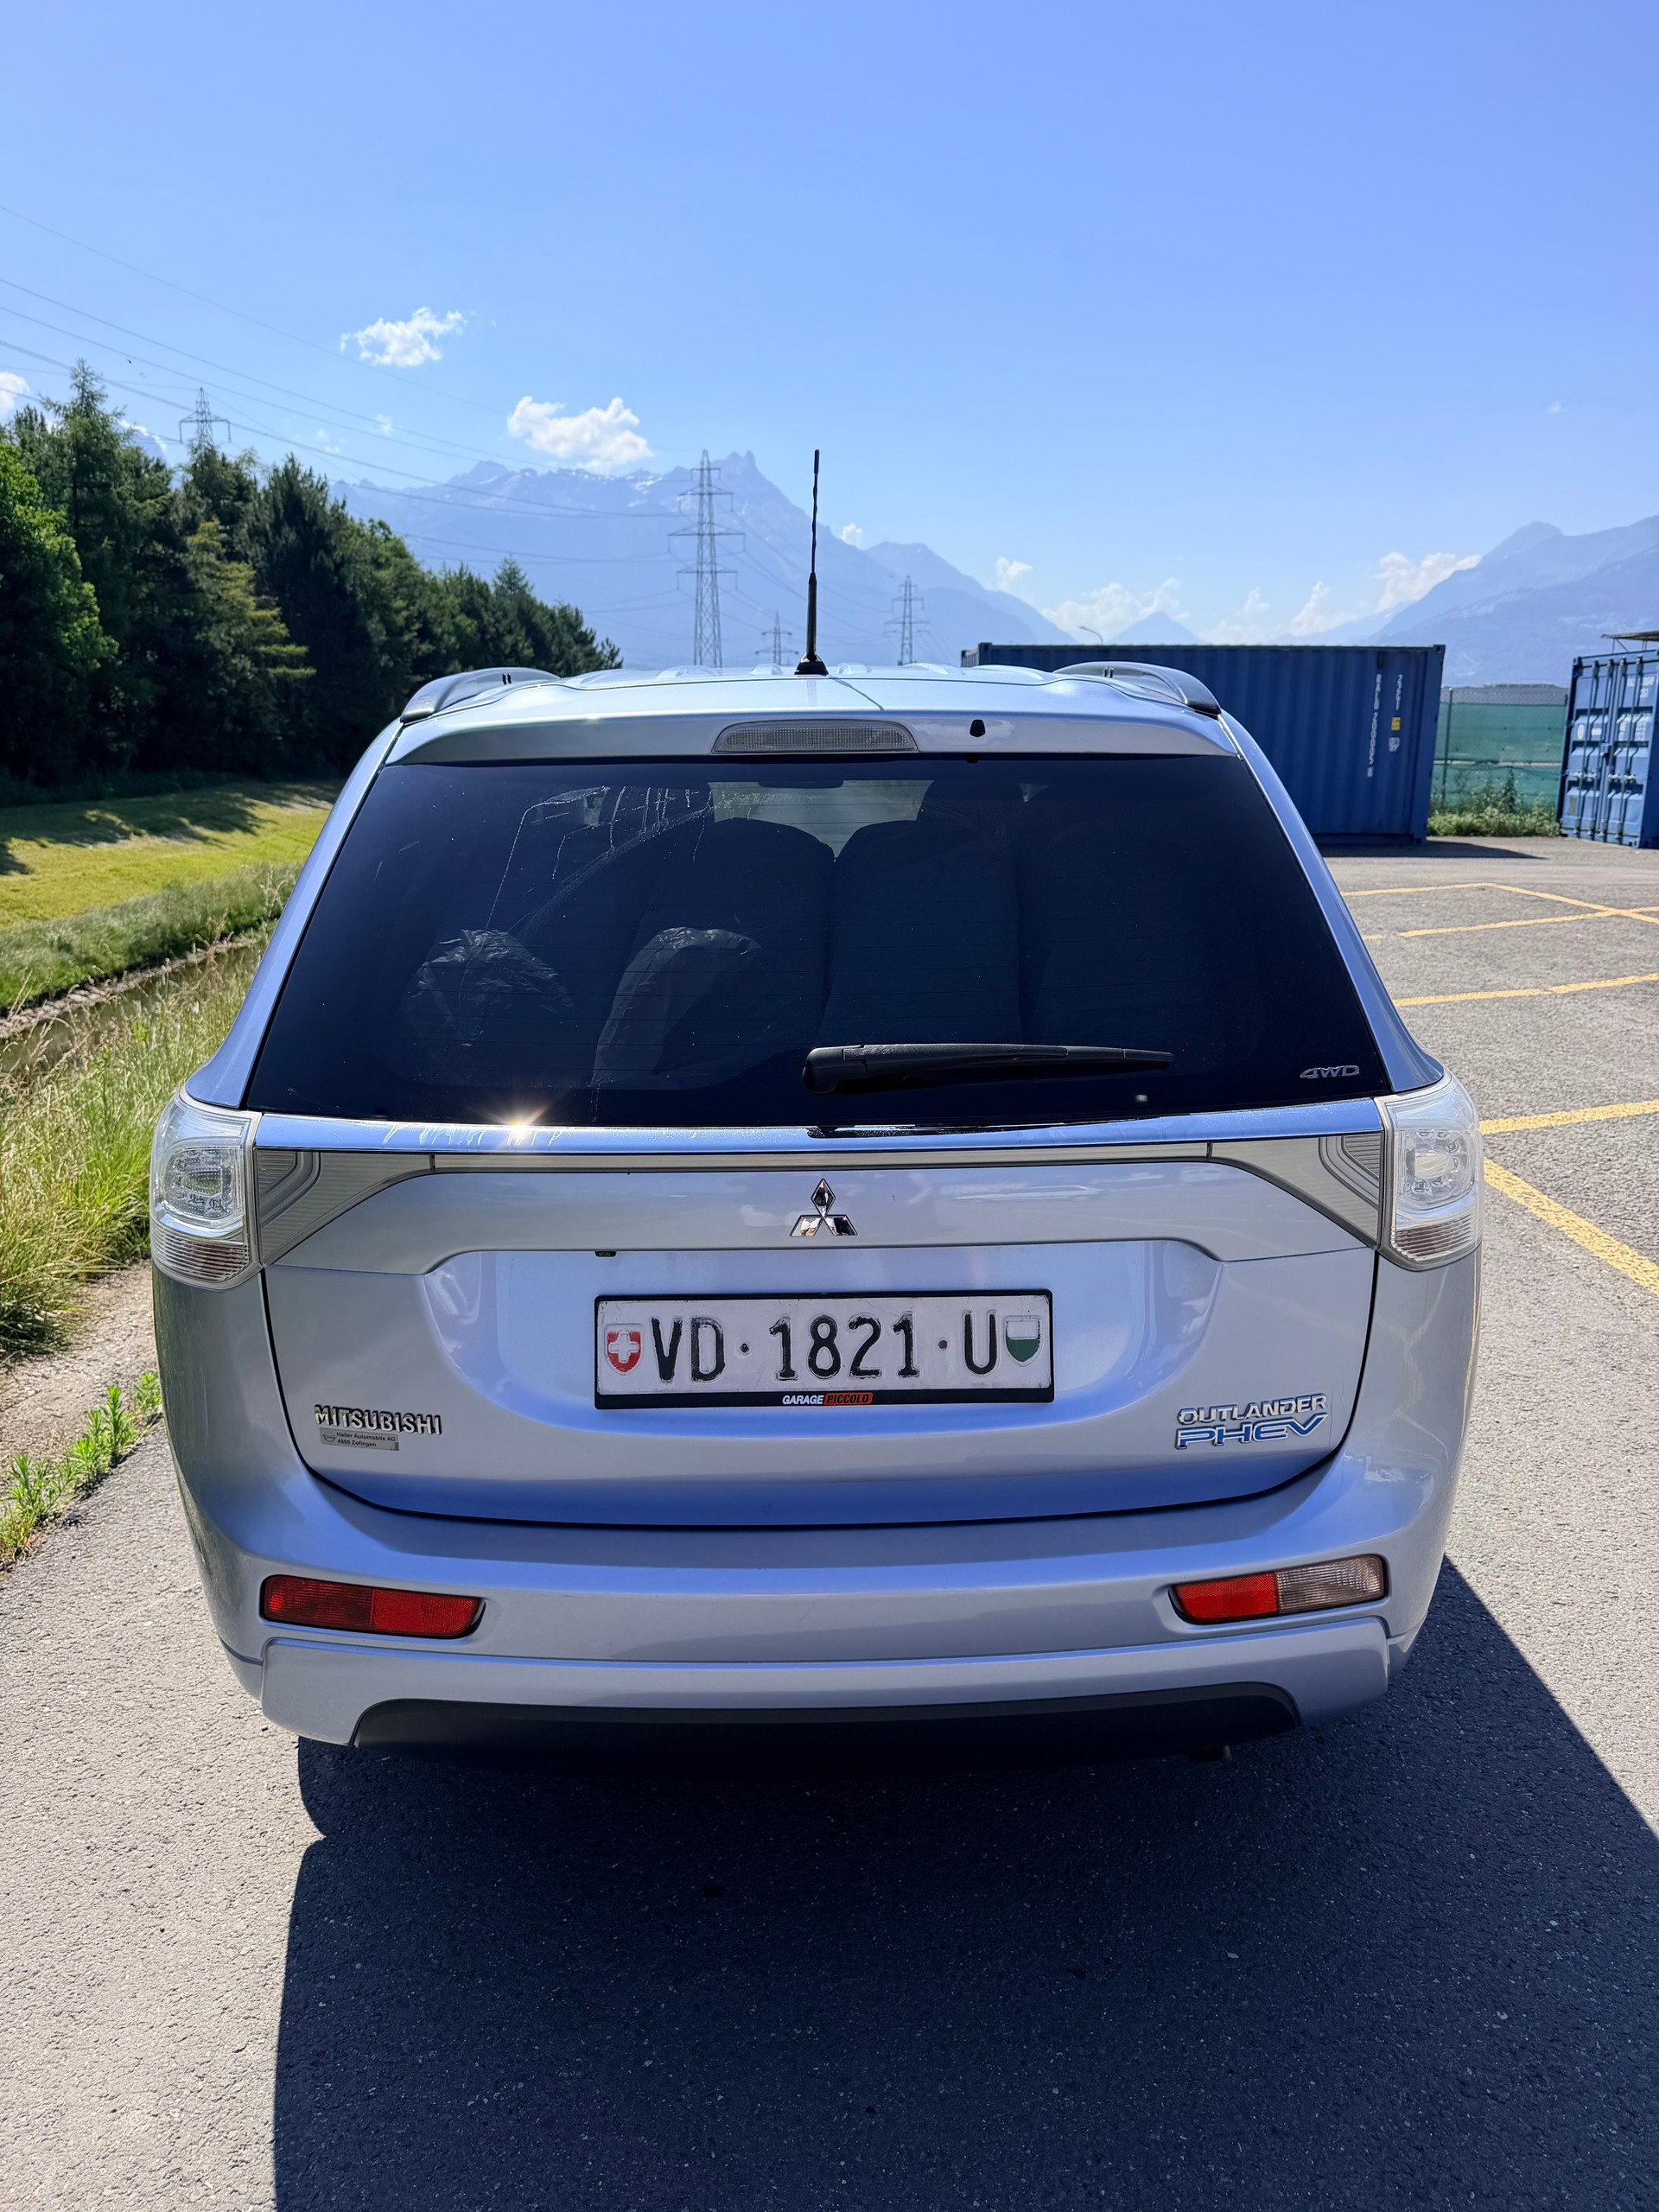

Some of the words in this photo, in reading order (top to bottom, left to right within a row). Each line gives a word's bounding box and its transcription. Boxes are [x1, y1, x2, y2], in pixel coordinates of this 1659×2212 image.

[1300, 1065, 1360, 1079] 4WD
[782, 1395, 824, 1405] GARAGE
[826, 1394, 870, 1404] PICCOLO
[1178, 1393, 1328, 1425] OUTLANDER
[314, 1404, 442, 1435] MITSUBISHI
[1175, 1412, 1329, 1450] PHEV
